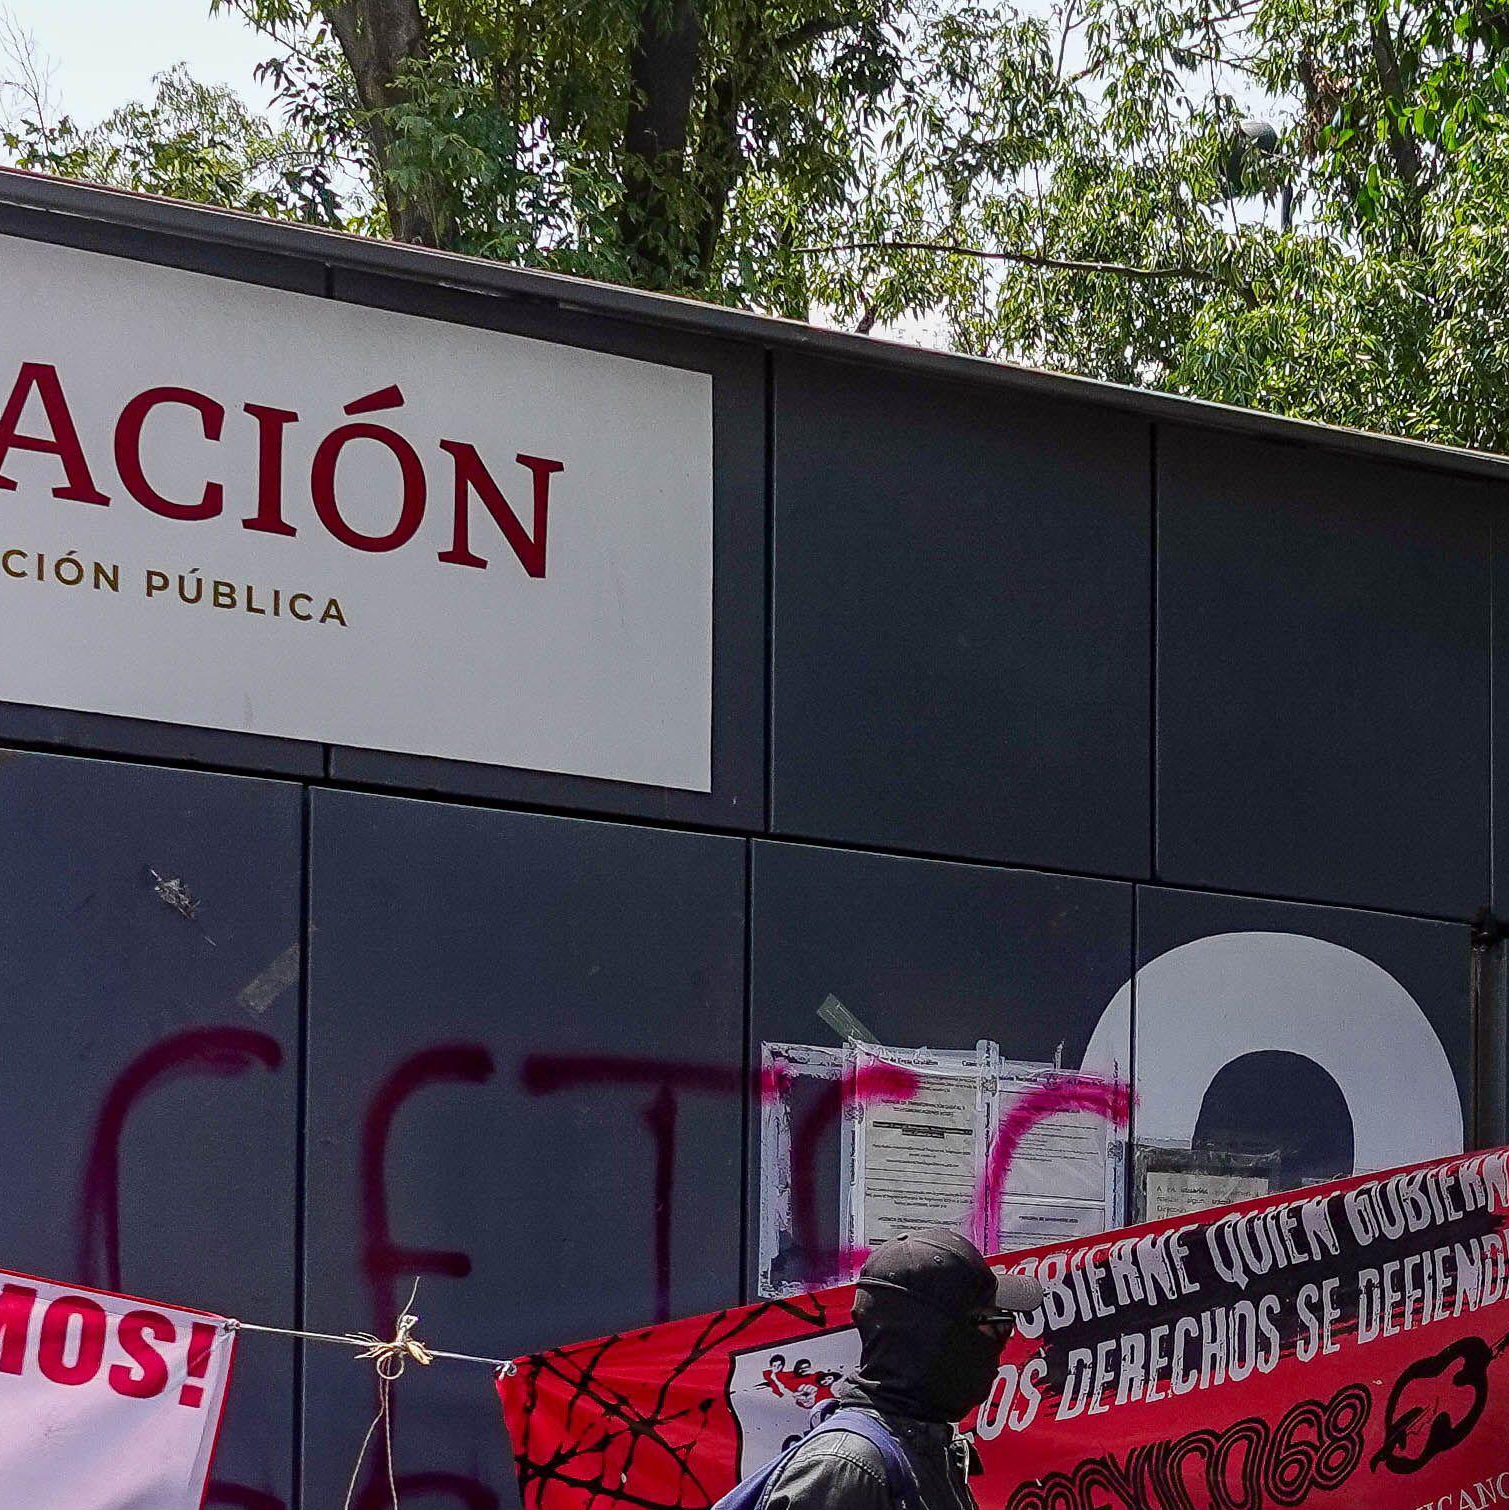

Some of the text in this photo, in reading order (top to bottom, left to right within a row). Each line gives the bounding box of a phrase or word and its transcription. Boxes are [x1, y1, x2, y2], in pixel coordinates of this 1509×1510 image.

[145, 568, 348, 627] PÚBLICA
[1205, 1190, 1340, 1291] QUIEN
[1054, 1294, 1281, 1422] DERECHOS
[1295, 1277, 1341, 1363] SE
